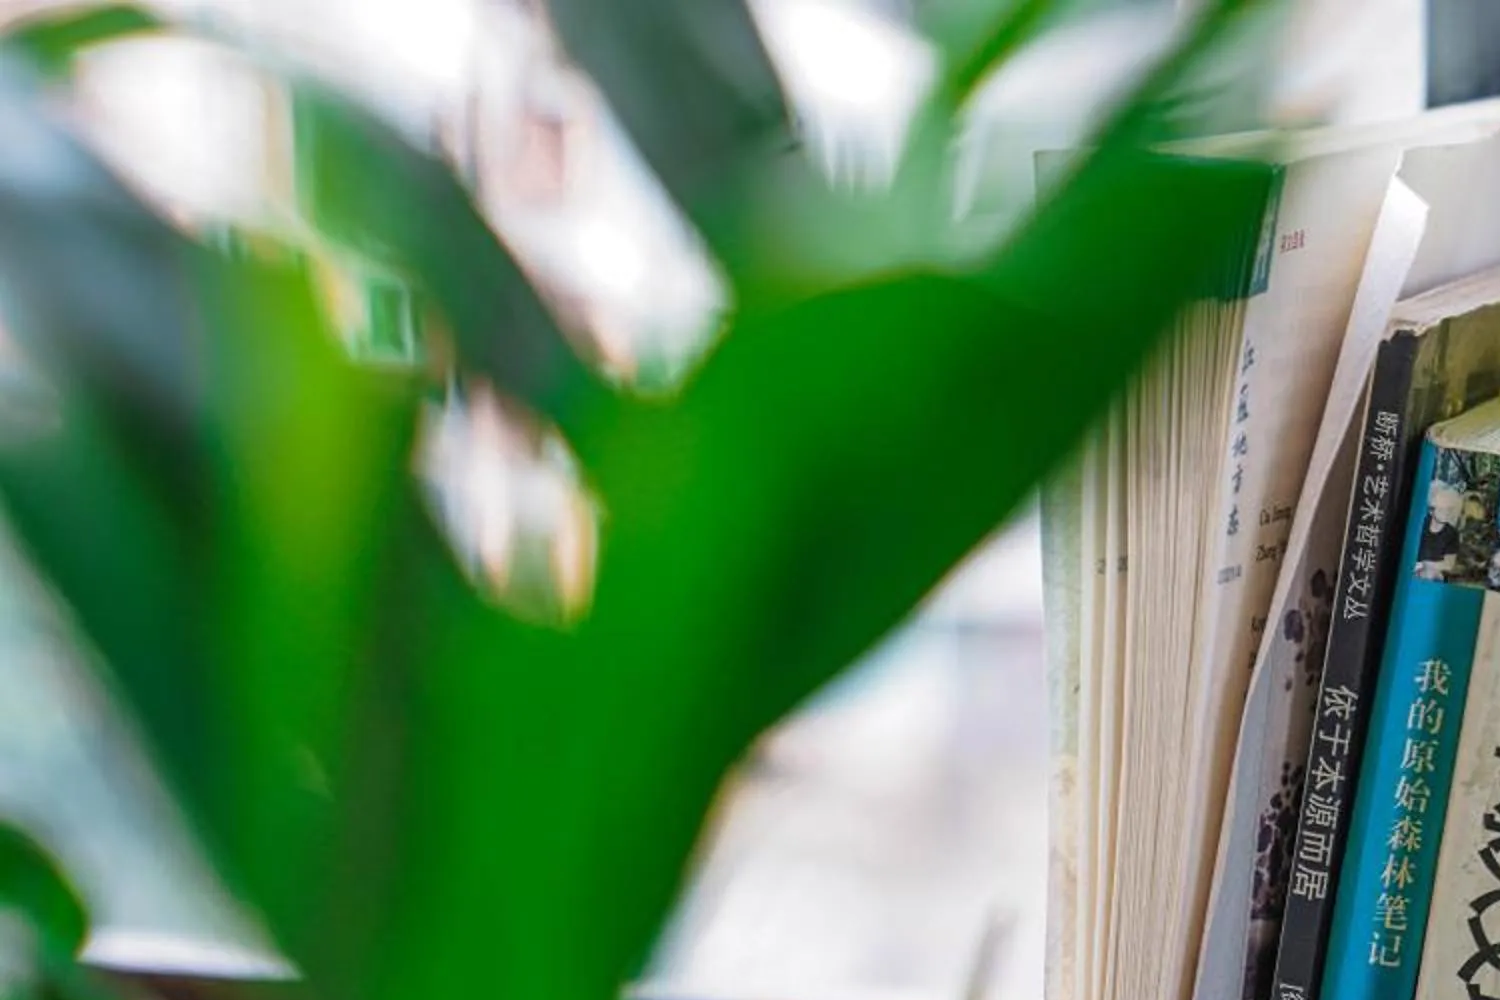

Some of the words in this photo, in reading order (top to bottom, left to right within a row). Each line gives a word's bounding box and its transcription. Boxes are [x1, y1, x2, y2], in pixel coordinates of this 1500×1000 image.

[1344, 411, 1399, 620] 断桥·艺术哲学文丛
[1292, 685, 1359, 900] 依于本源而居
[1367, 658, 1453, 968] 我的原始森林笔记
